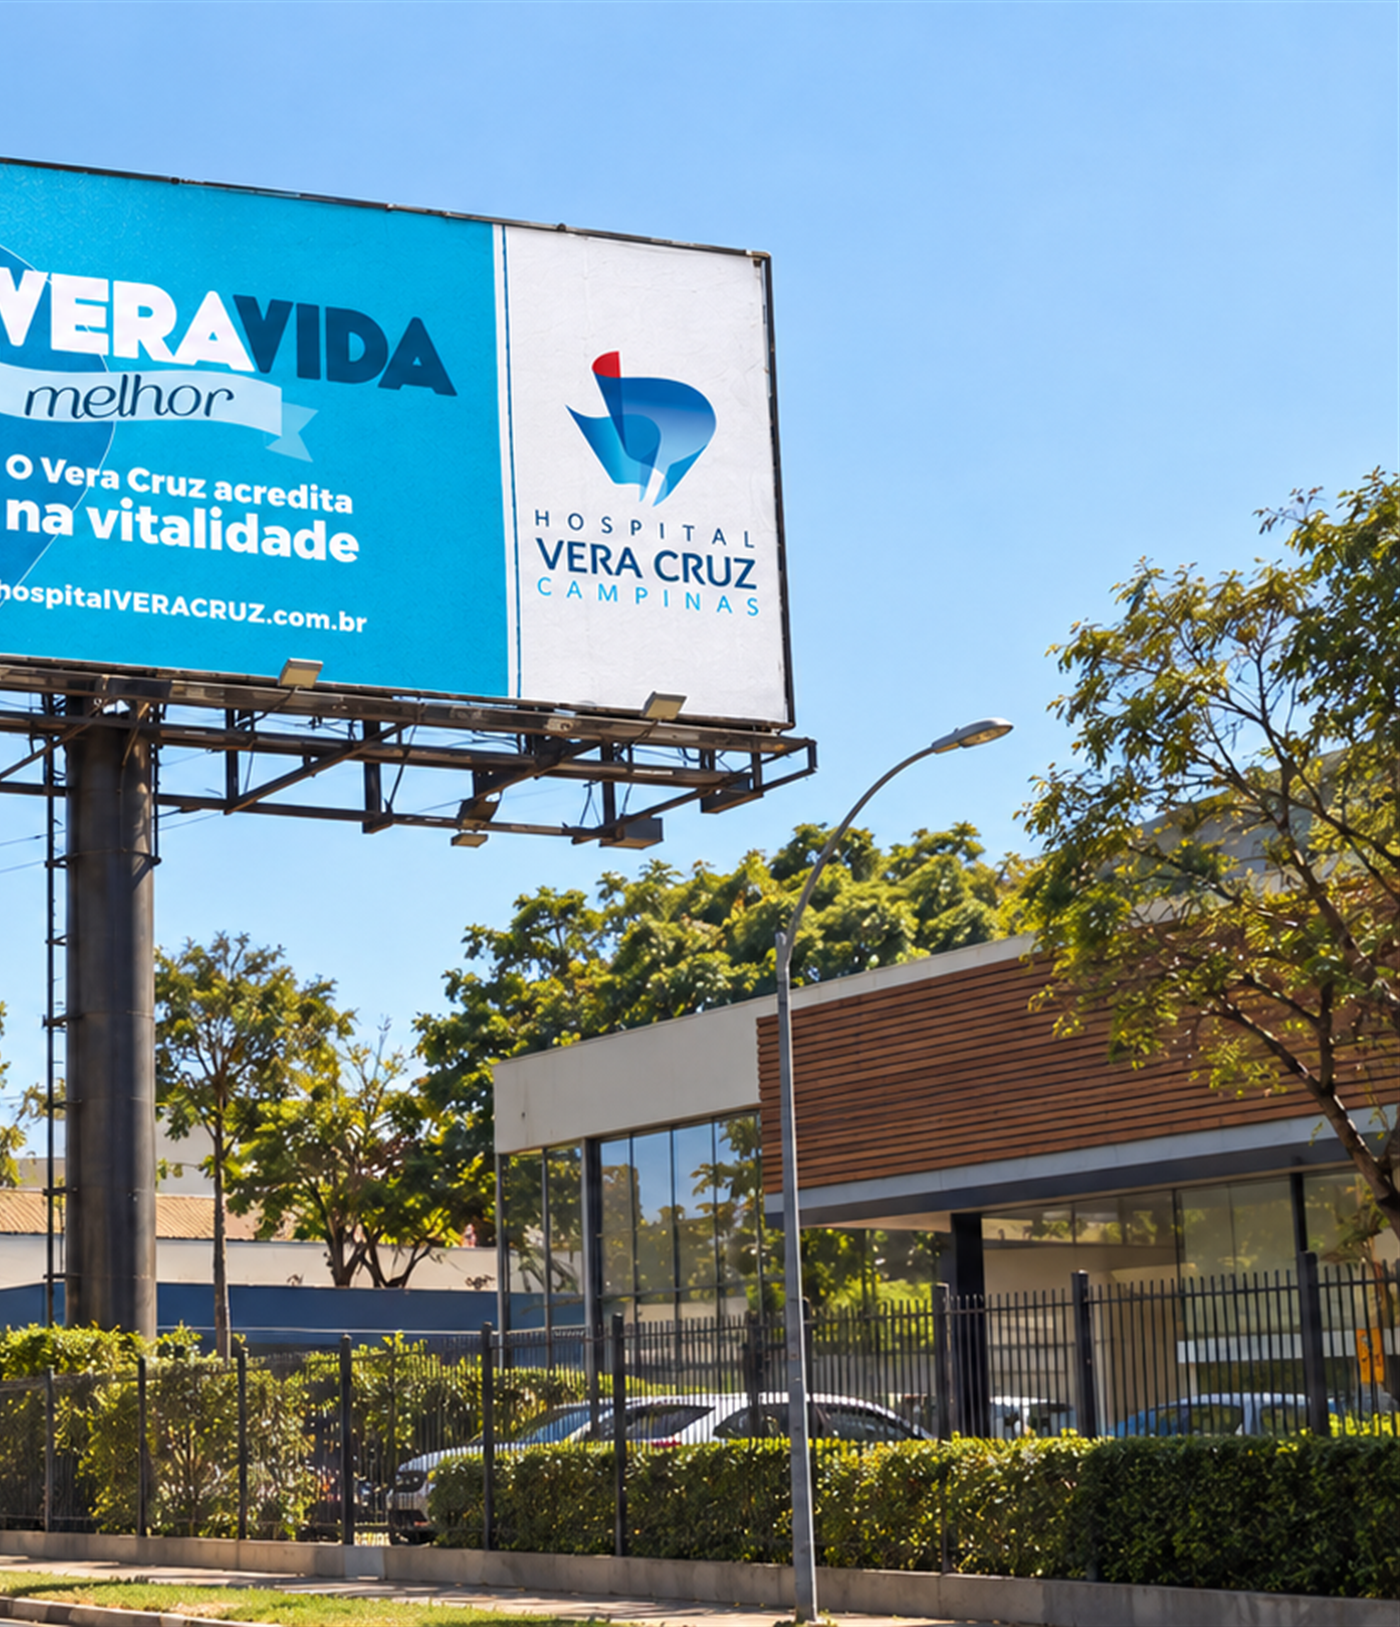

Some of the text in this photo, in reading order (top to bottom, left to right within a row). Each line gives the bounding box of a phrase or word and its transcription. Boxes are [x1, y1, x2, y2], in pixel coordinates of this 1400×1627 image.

[24, 374, 234, 419] melhor
[6, 454, 353, 514] O Vera Cruz acredita
[6, 498, 359, 563] na vitalidade
[535, 510, 754, 548] HOSPITAL
[535, 538, 757, 590] VERA CRUZ
[537, 577, 759, 616] CAMPINAS
